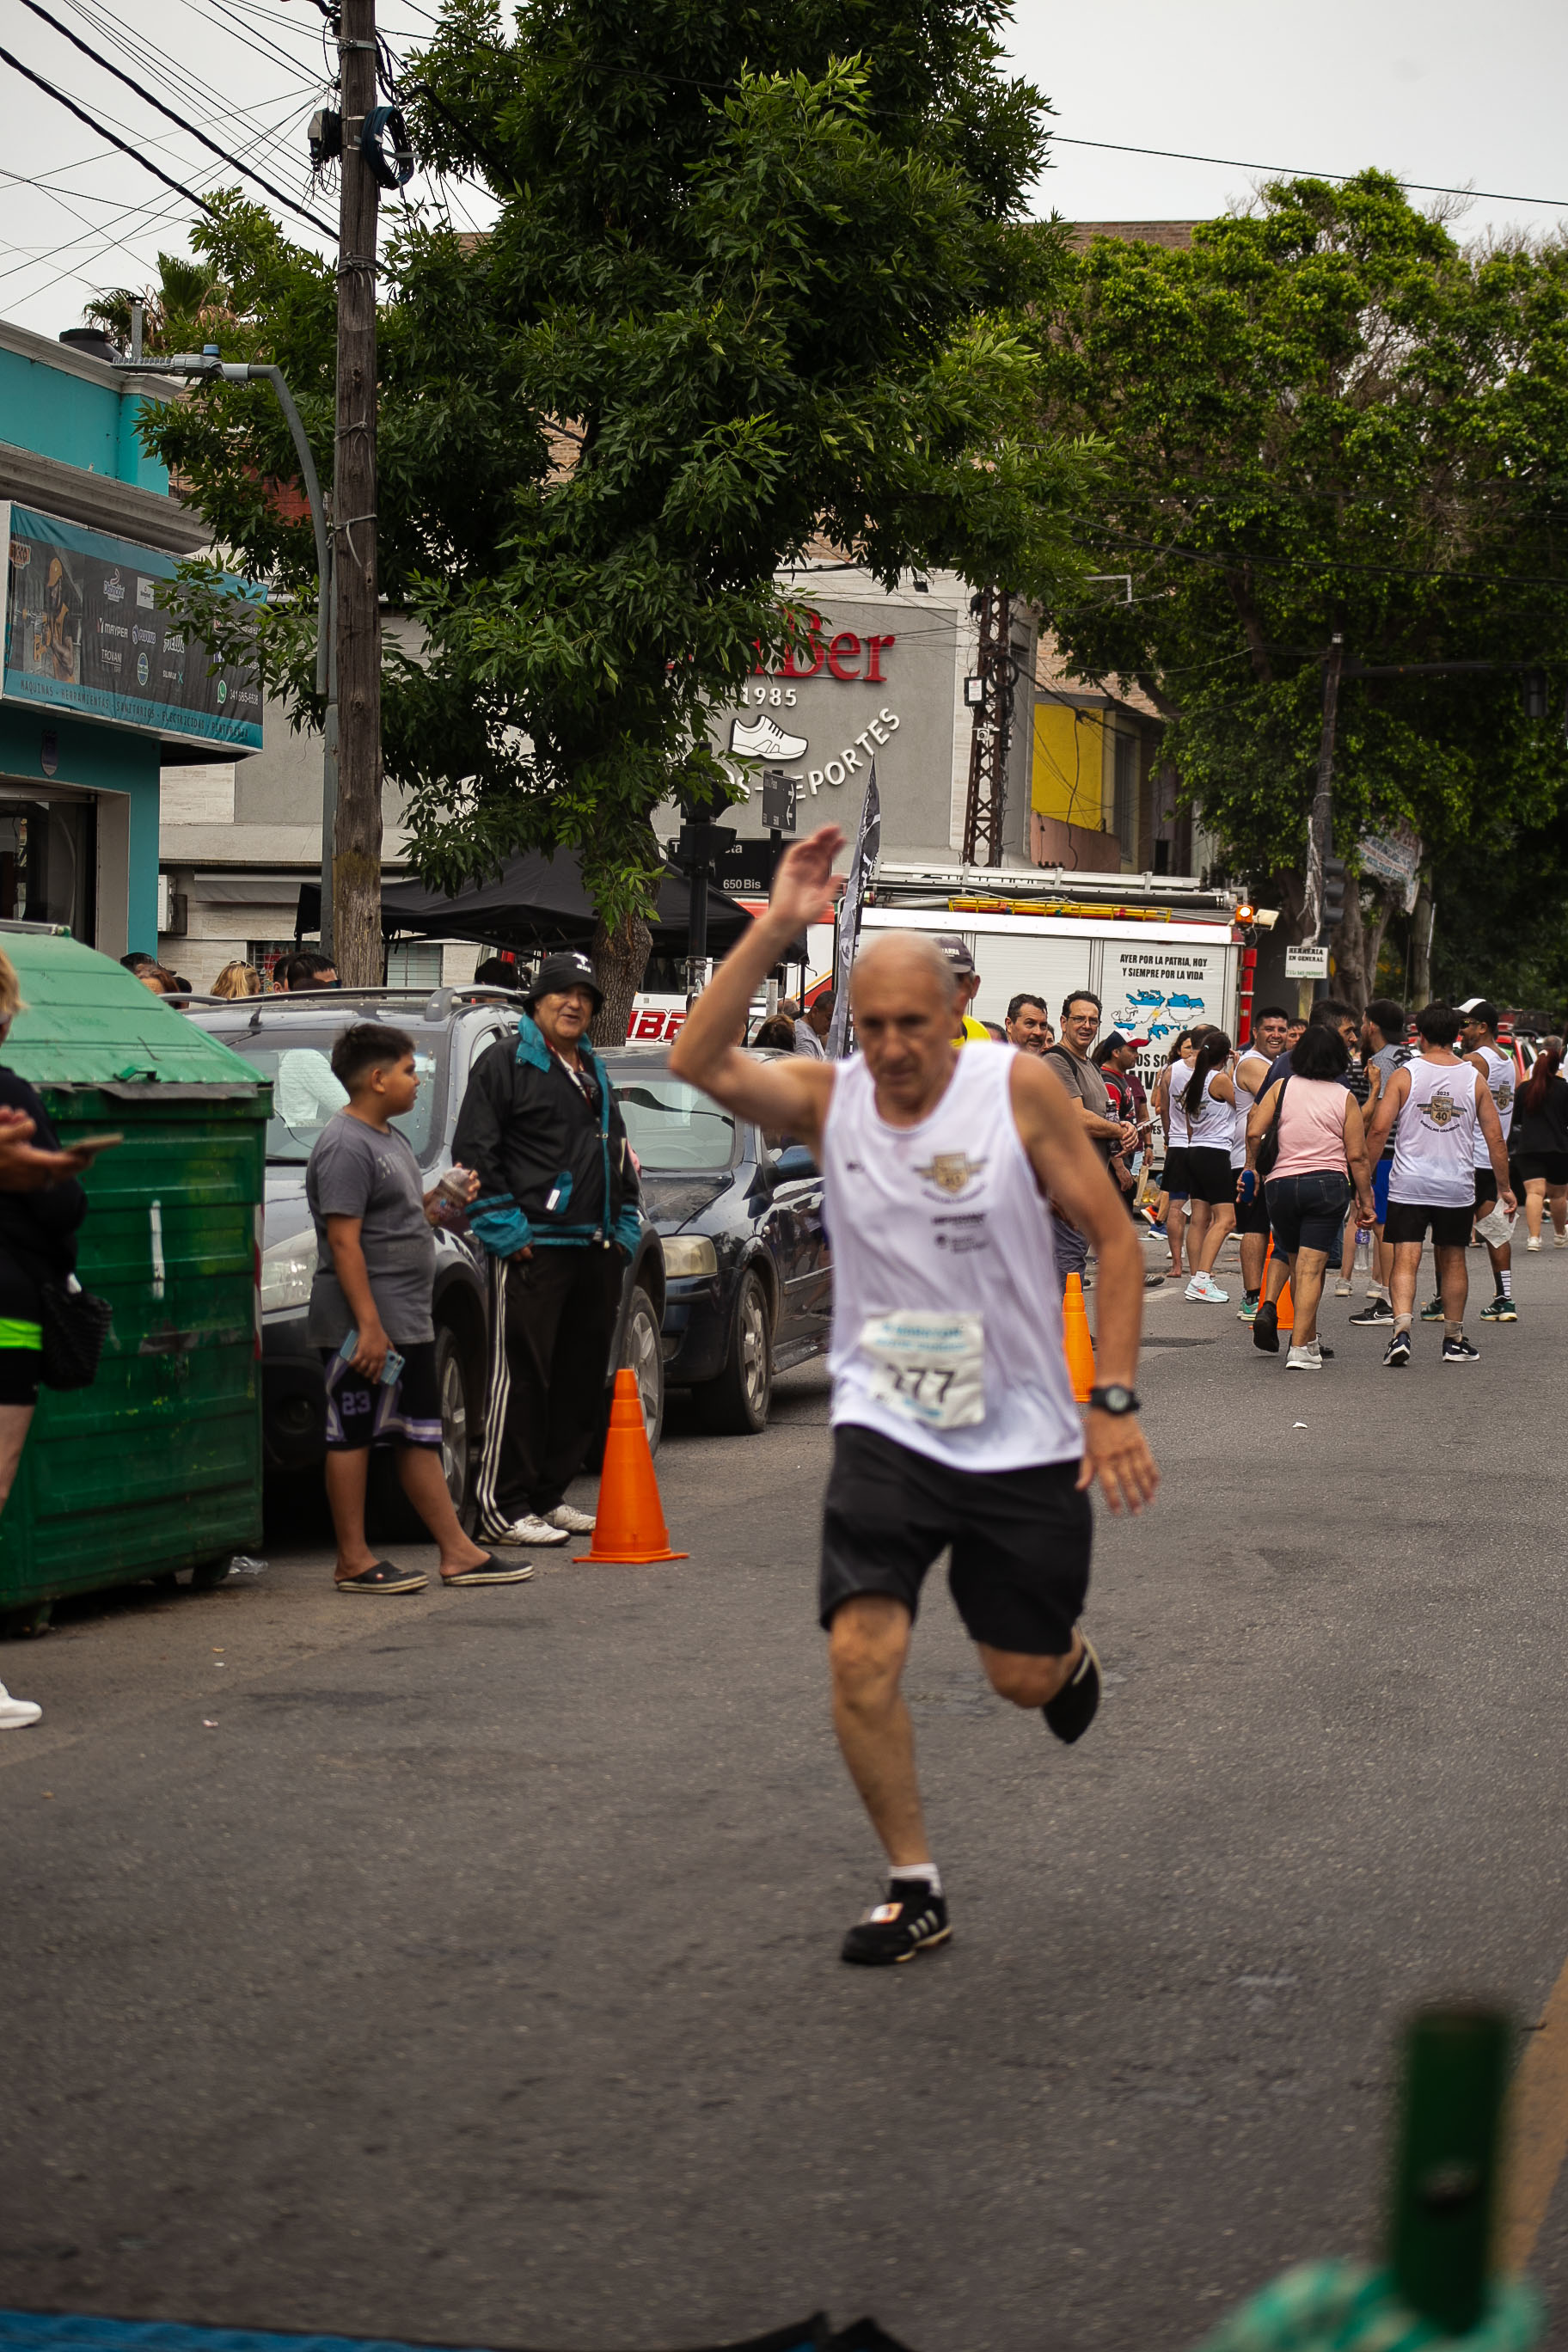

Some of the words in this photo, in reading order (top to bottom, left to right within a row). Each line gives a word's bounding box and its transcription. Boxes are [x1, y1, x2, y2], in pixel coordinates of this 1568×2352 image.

[742, 687, 798, 707] 1985
[795, 707, 901, 800] EPORTES
[723, 879, 743, 890] 650
[744, 879, 762, 890] Bis
[1119, 953, 1137, 964] AYER
[1138, 955, 1154, 965] POR
[1155, 956, 1163, 965] LA
[1164, 956, 1191, 967] PATRIA,
[1192, 958, 1208, 967] HOY
[1122, 967, 1127, 977] Y
[1128, 968, 1160, 978] SIEMPRE
[1161, 970, 1175, 979] POR
[1176, 971, 1185, 979] LA
[1186, 971, 1204, 981] VIDA
[1435, 1112, 1448, 1121] 40
[342, 1391, 371, 1415] 23
